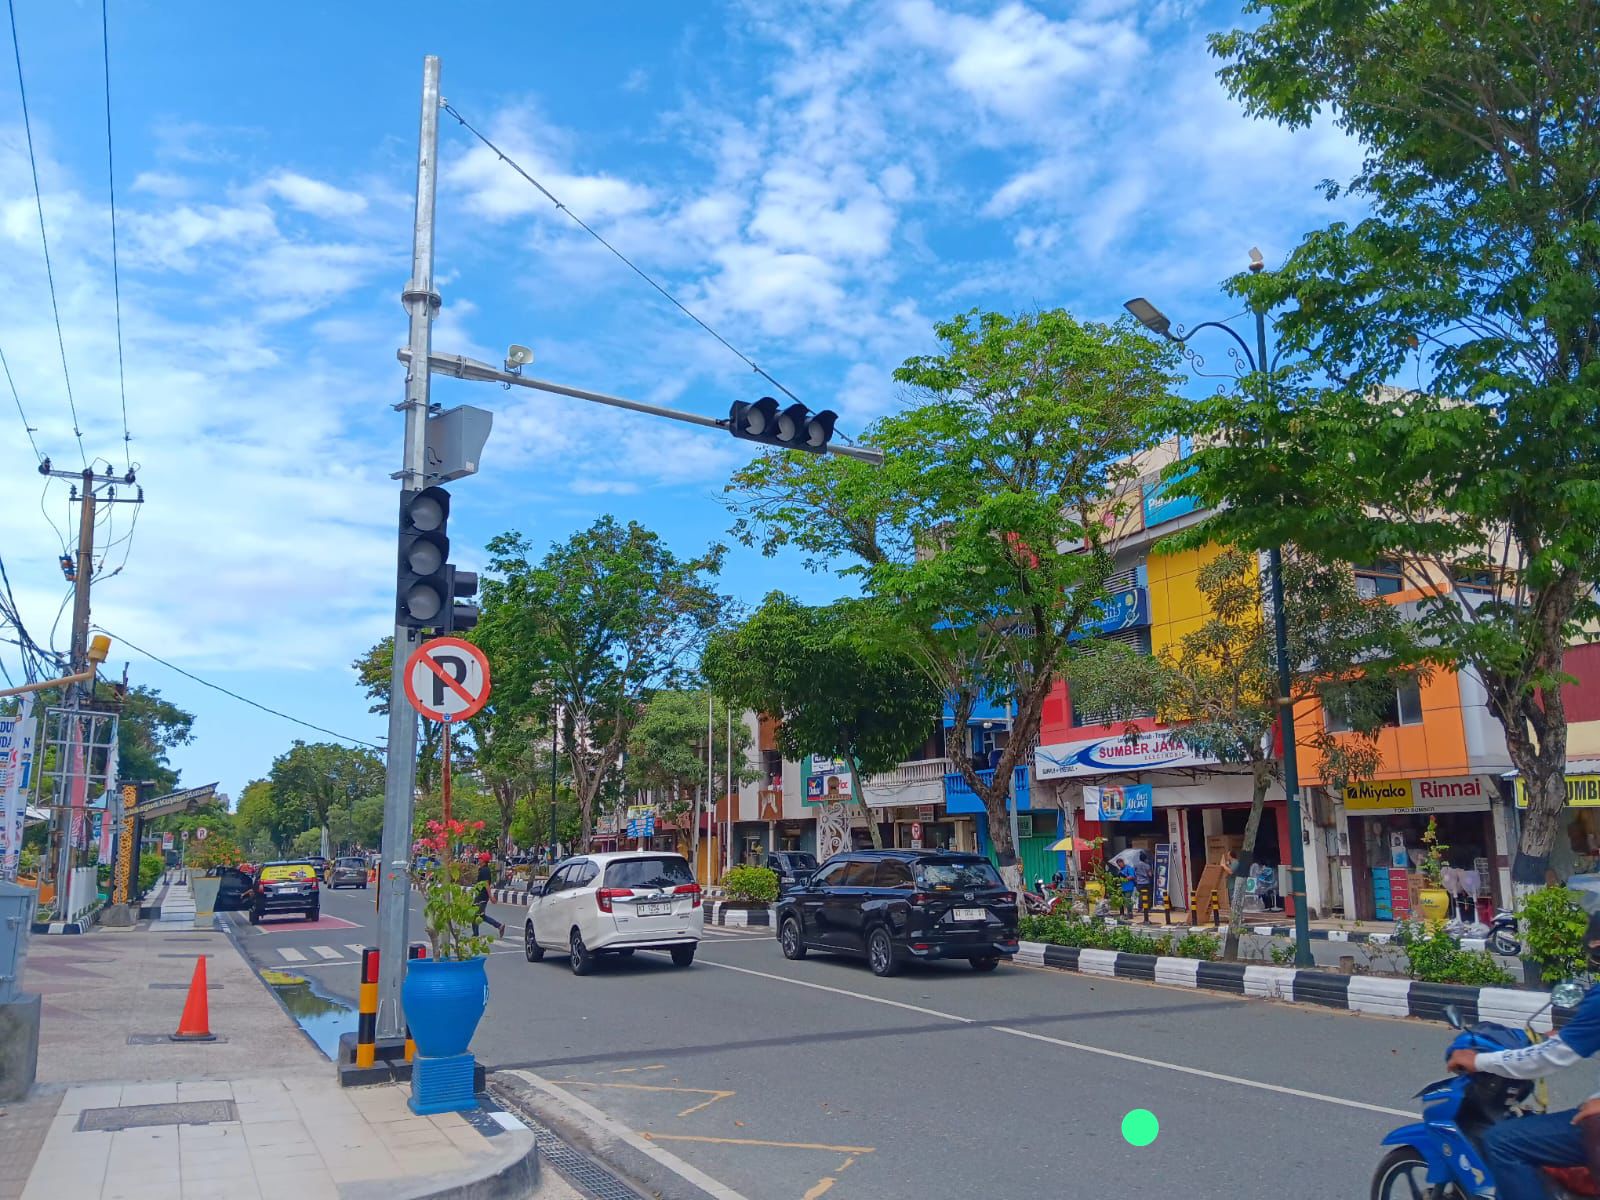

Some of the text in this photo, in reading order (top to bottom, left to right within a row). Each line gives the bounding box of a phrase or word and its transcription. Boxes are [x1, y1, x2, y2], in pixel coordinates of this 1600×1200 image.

[433, 656, 466, 706] P
[1099, 743, 1149, 759] SUMBER
[1359, 784, 1406, 802] Miyako
[1420, 778, 1481, 799] Rinnai
